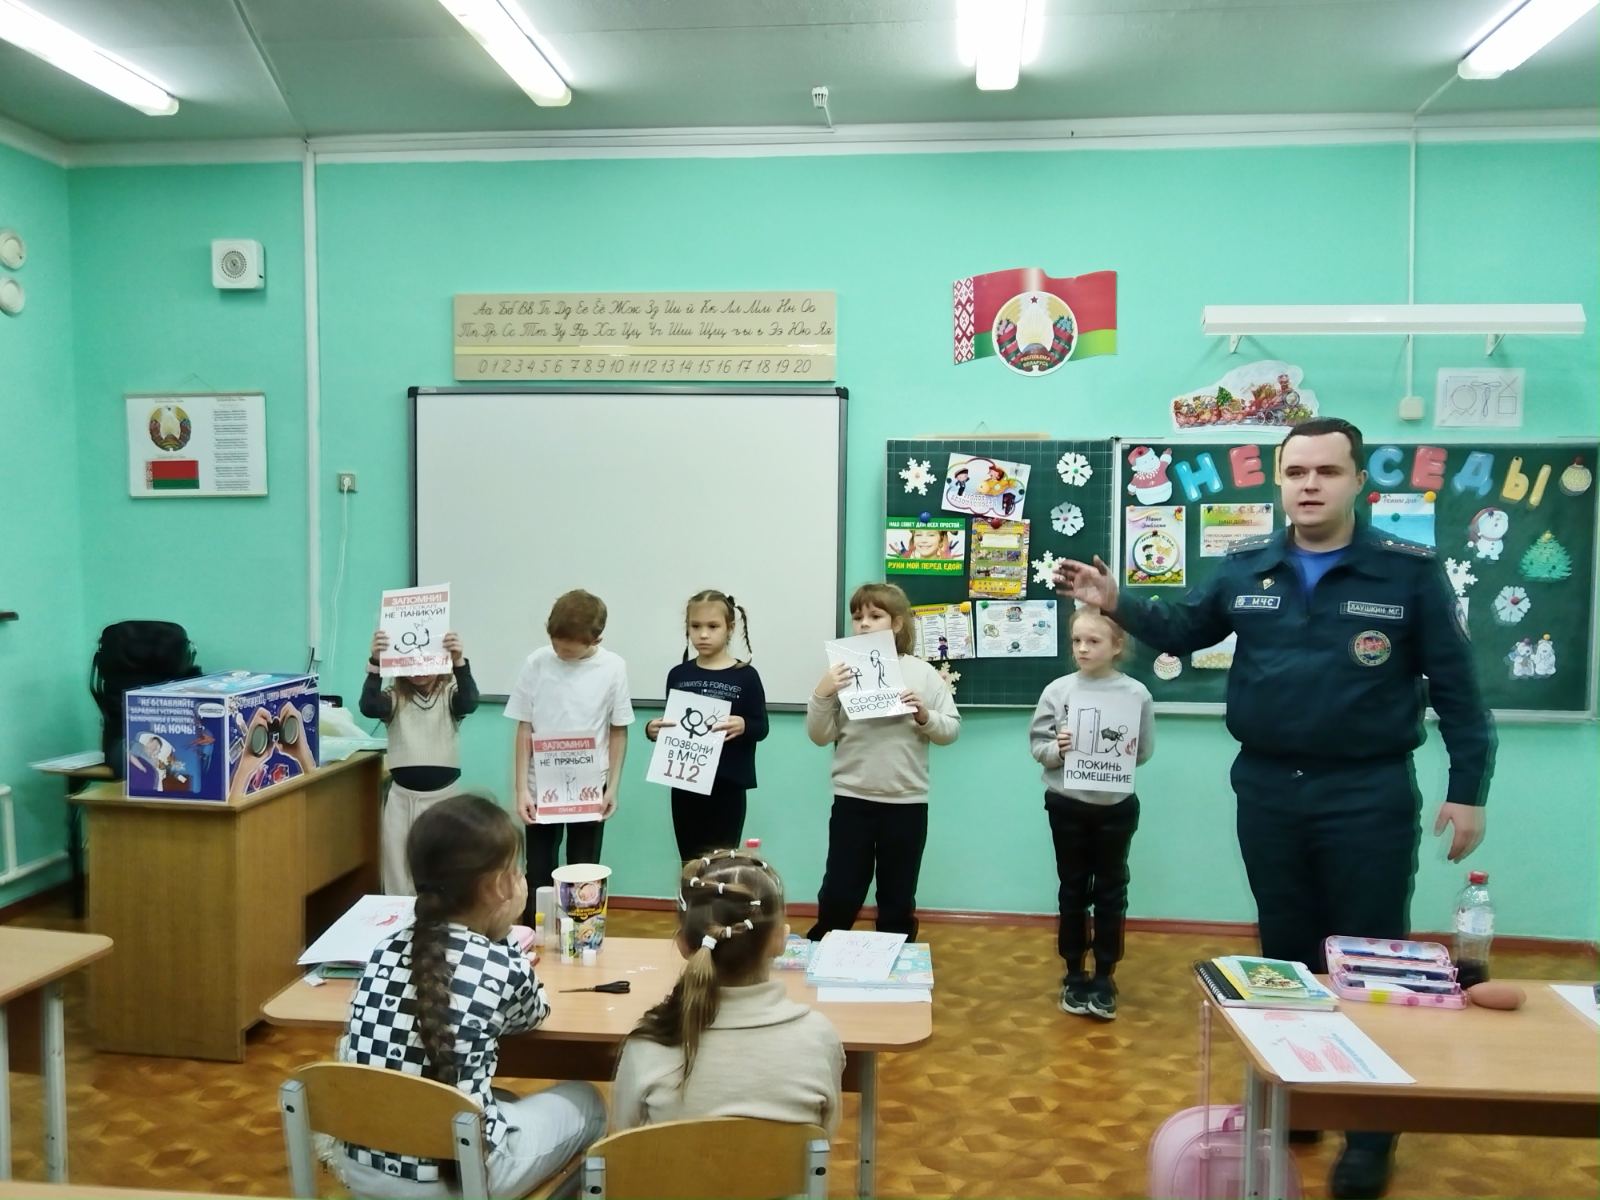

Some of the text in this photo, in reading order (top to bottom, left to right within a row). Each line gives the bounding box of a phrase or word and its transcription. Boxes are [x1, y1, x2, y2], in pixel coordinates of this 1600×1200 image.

[473, 300, 493, 315] Аа
[498, 300, 517, 315] Бб
[518, 300, 535, 315] Вв
[554, 300, 572, 320] Дд
[576, 300, 589, 315] Ее
[608, 300, 641, 315] Жж
[645, 299, 660, 319] Зз
[664, 299, 681, 314] Ии
[699, 299, 718, 314] Кк
[720, 299, 741, 314] Лл
[742, 299, 773, 314] Мм
[776, 298, 796, 313] Нн
[800, 298, 816, 313] Оо
[457, 322, 480, 338] Пп
[501, 322, 516, 337] Сс
[519, 322, 548, 337] Тт
[551, 322, 566, 342] Уу
[569, 322, 589, 342] Фф
[592, 322, 617, 337] Хх
[621, 322, 642, 339] Цц
[648, 321, 663, 336] Чч
[668, 321, 693, 336] Шш
[699, 321, 727, 339] Щщ
[768, 321, 784, 336] Ээ
[787, 321, 811, 336] Юю
[814, 321, 832, 336] Яя
[478, 359, 812, 374] 0 1 2 3 4 5 6 7 8 9 10 11 12 13 14 15 16 17 18 19 20
[1174, 444, 1551, 508] НЕСЕДЫ
[922, 562, 942, 570] ПЕРЕД
[392, 594, 441, 605] ЗАПОМНИ!
[1252, 598, 1274, 606] МЧС
[400, 607, 446, 618] ПАНИКУЙ!
[709, 680, 742, 692] FOREVER
[154, 724, 196, 734] НА НОЧЬ!
[542, 740, 590, 750] ЗАПОМНИ!
[665, 736, 713, 755] ПОЗВОНИ
[554, 755, 594, 766] ПРЯЧЬСЯ!
[667, 749, 708, 766] В МЧС
[664, 759, 700, 783] 112
[1077, 759, 1122, 771] ПОКИНЬ
[1066, 770, 1132, 783] ПОМЕЩЕНИЕ
